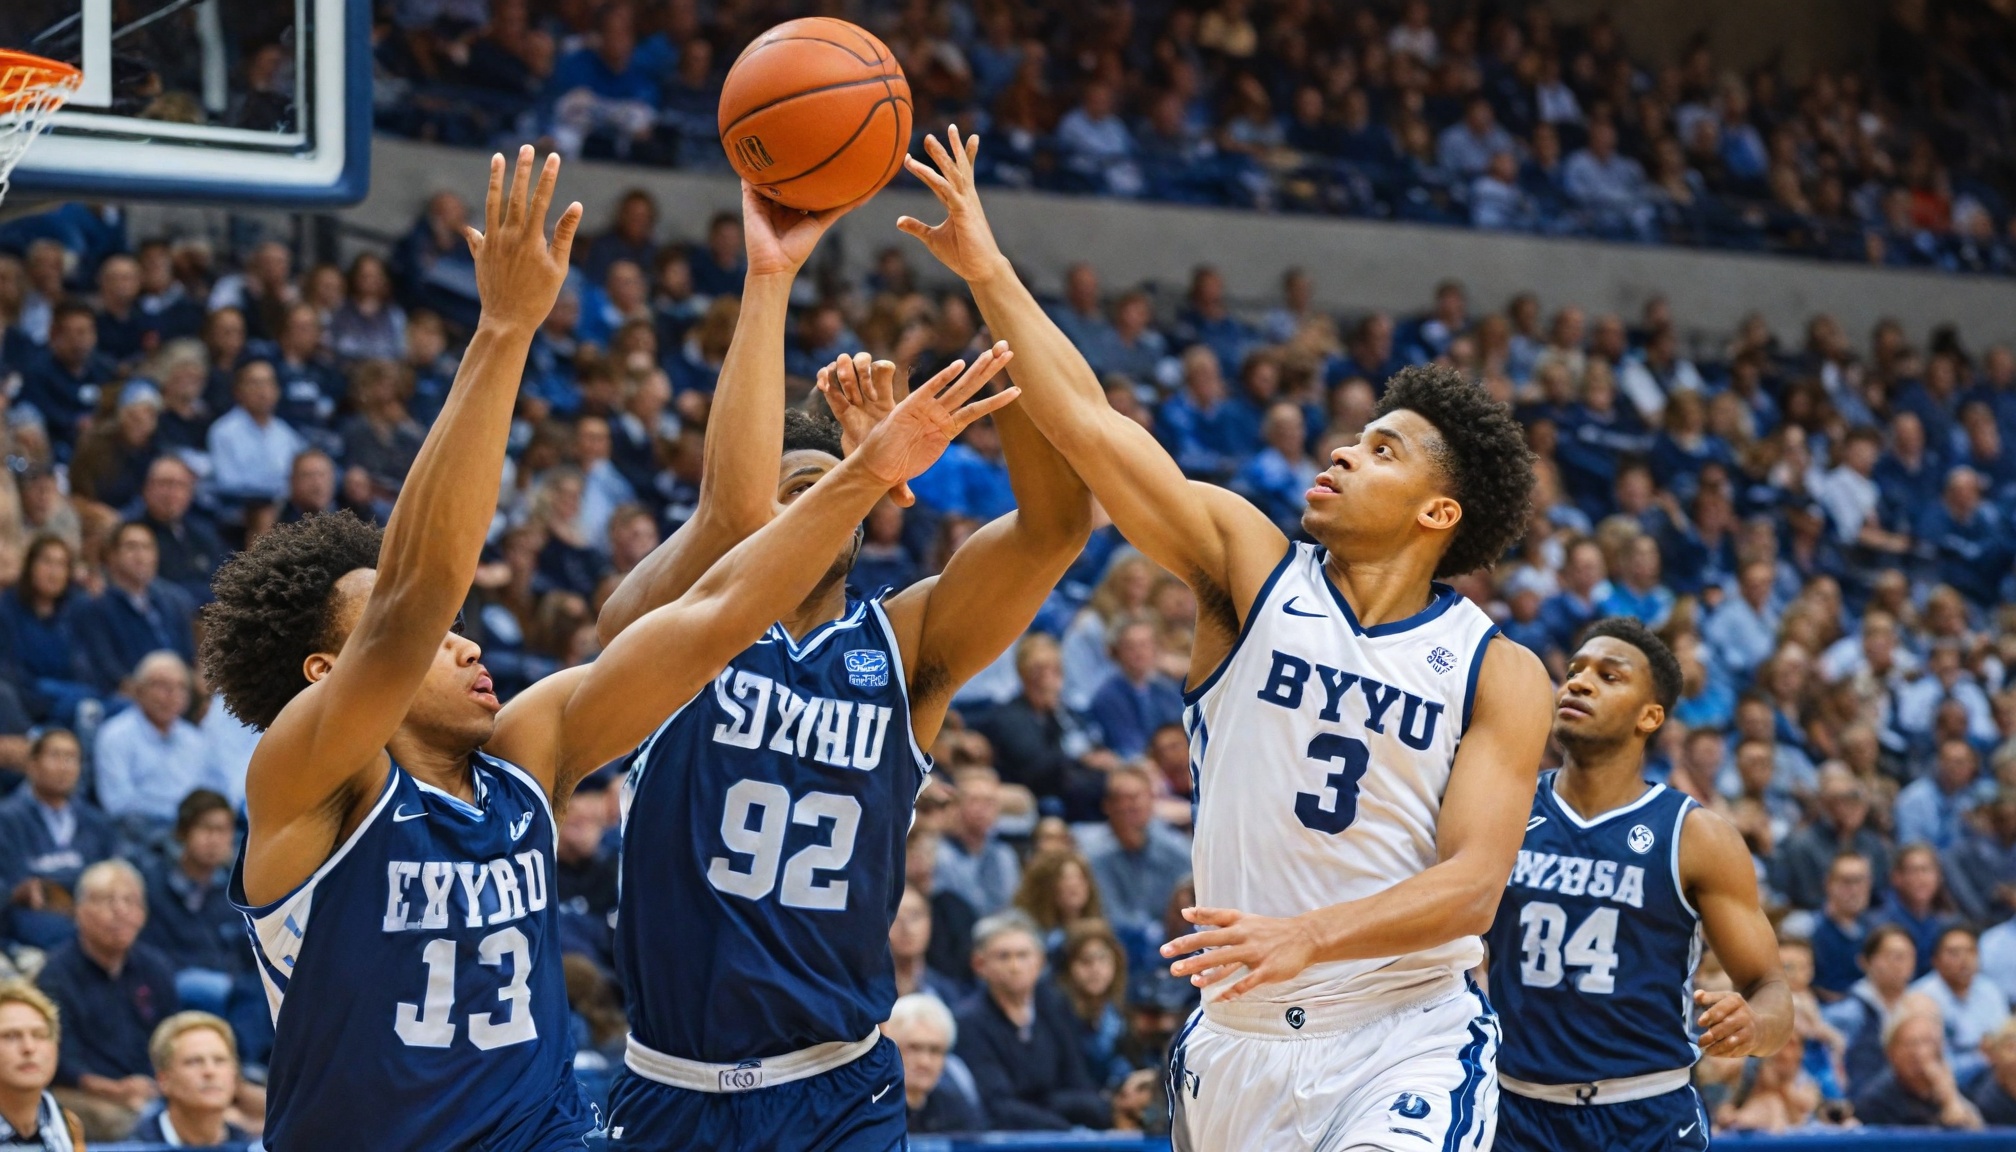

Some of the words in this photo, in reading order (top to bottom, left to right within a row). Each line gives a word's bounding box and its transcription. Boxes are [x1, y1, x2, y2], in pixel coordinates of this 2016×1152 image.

[1257, 649, 1446, 751] BYYU
[1294, 732, 1370, 835] 3
[706, 778, 862, 911] 92
[394, 926, 538, 1051] 13
